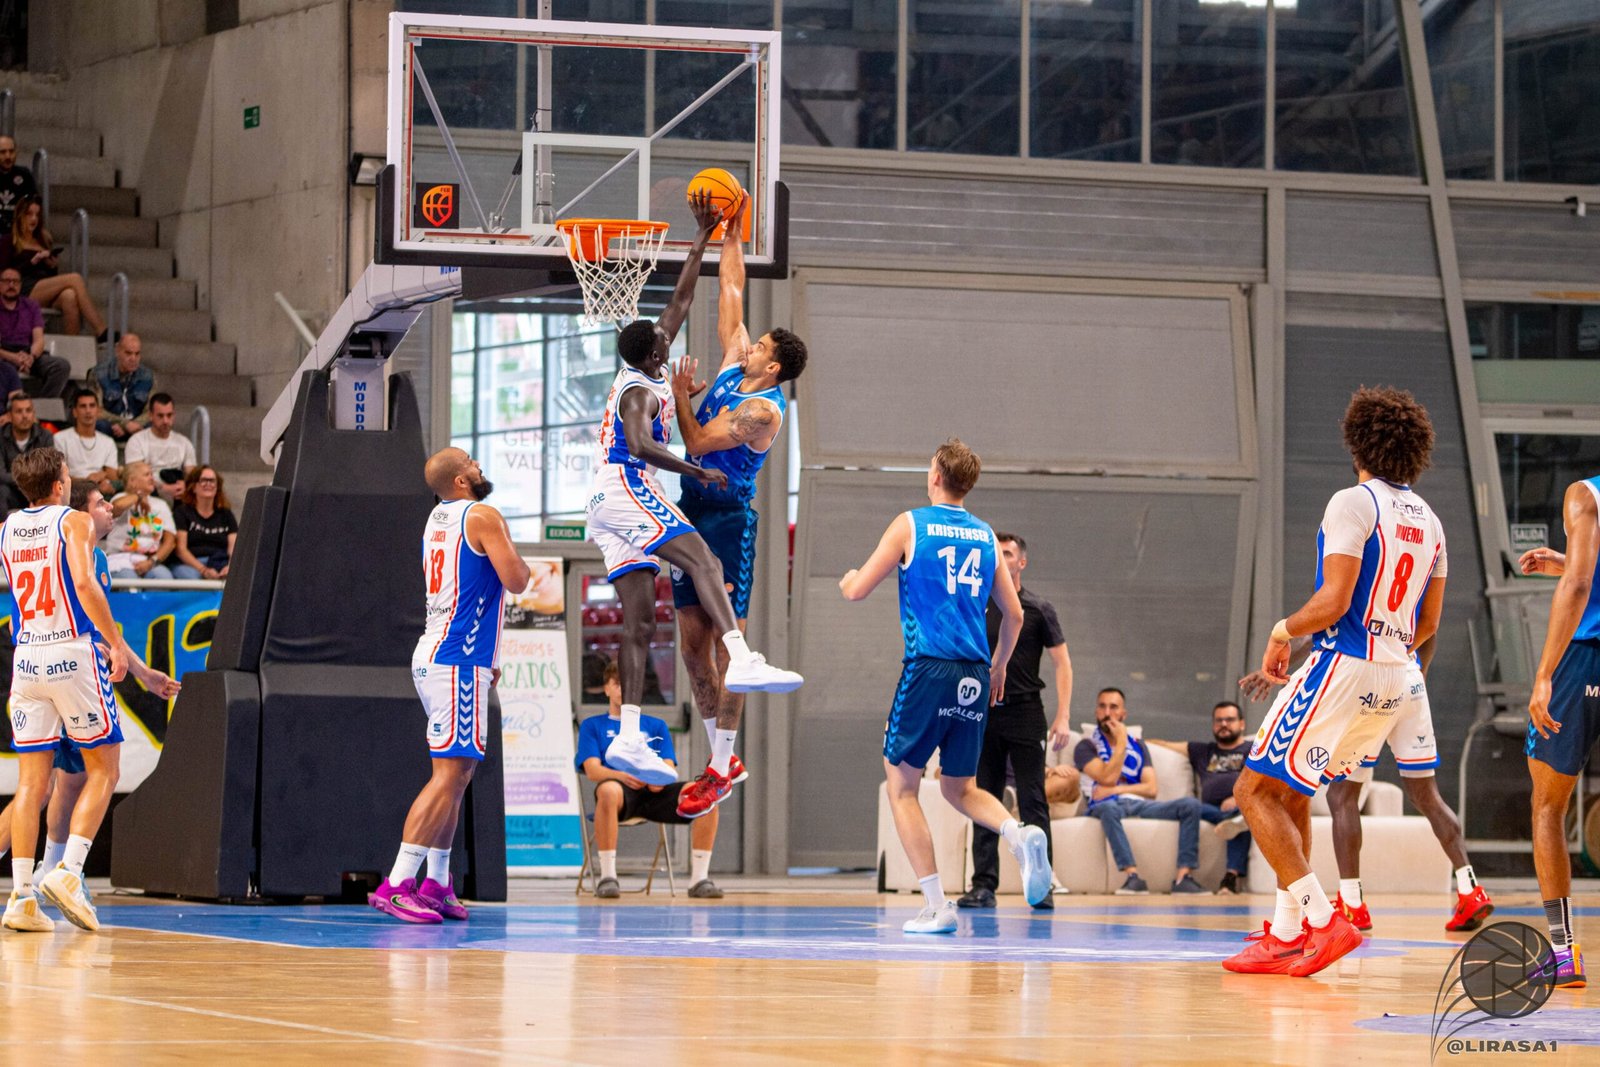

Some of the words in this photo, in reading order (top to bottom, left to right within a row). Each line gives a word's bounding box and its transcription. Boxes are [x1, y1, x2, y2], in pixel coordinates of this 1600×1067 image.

[505, 453, 591, 471] VALENCI
[13, 526, 49, 538] Kosner
[927, 523, 989, 543] KRISTENSEN
[12, 546, 48, 563] LLORENTE
[429, 549, 445, 594] 13
[937, 545, 983, 597] 14
[1387, 552, 1414, 612] 8
[16, 566, 56, 620] 24
[499, 661, 561, 690] CADOS
